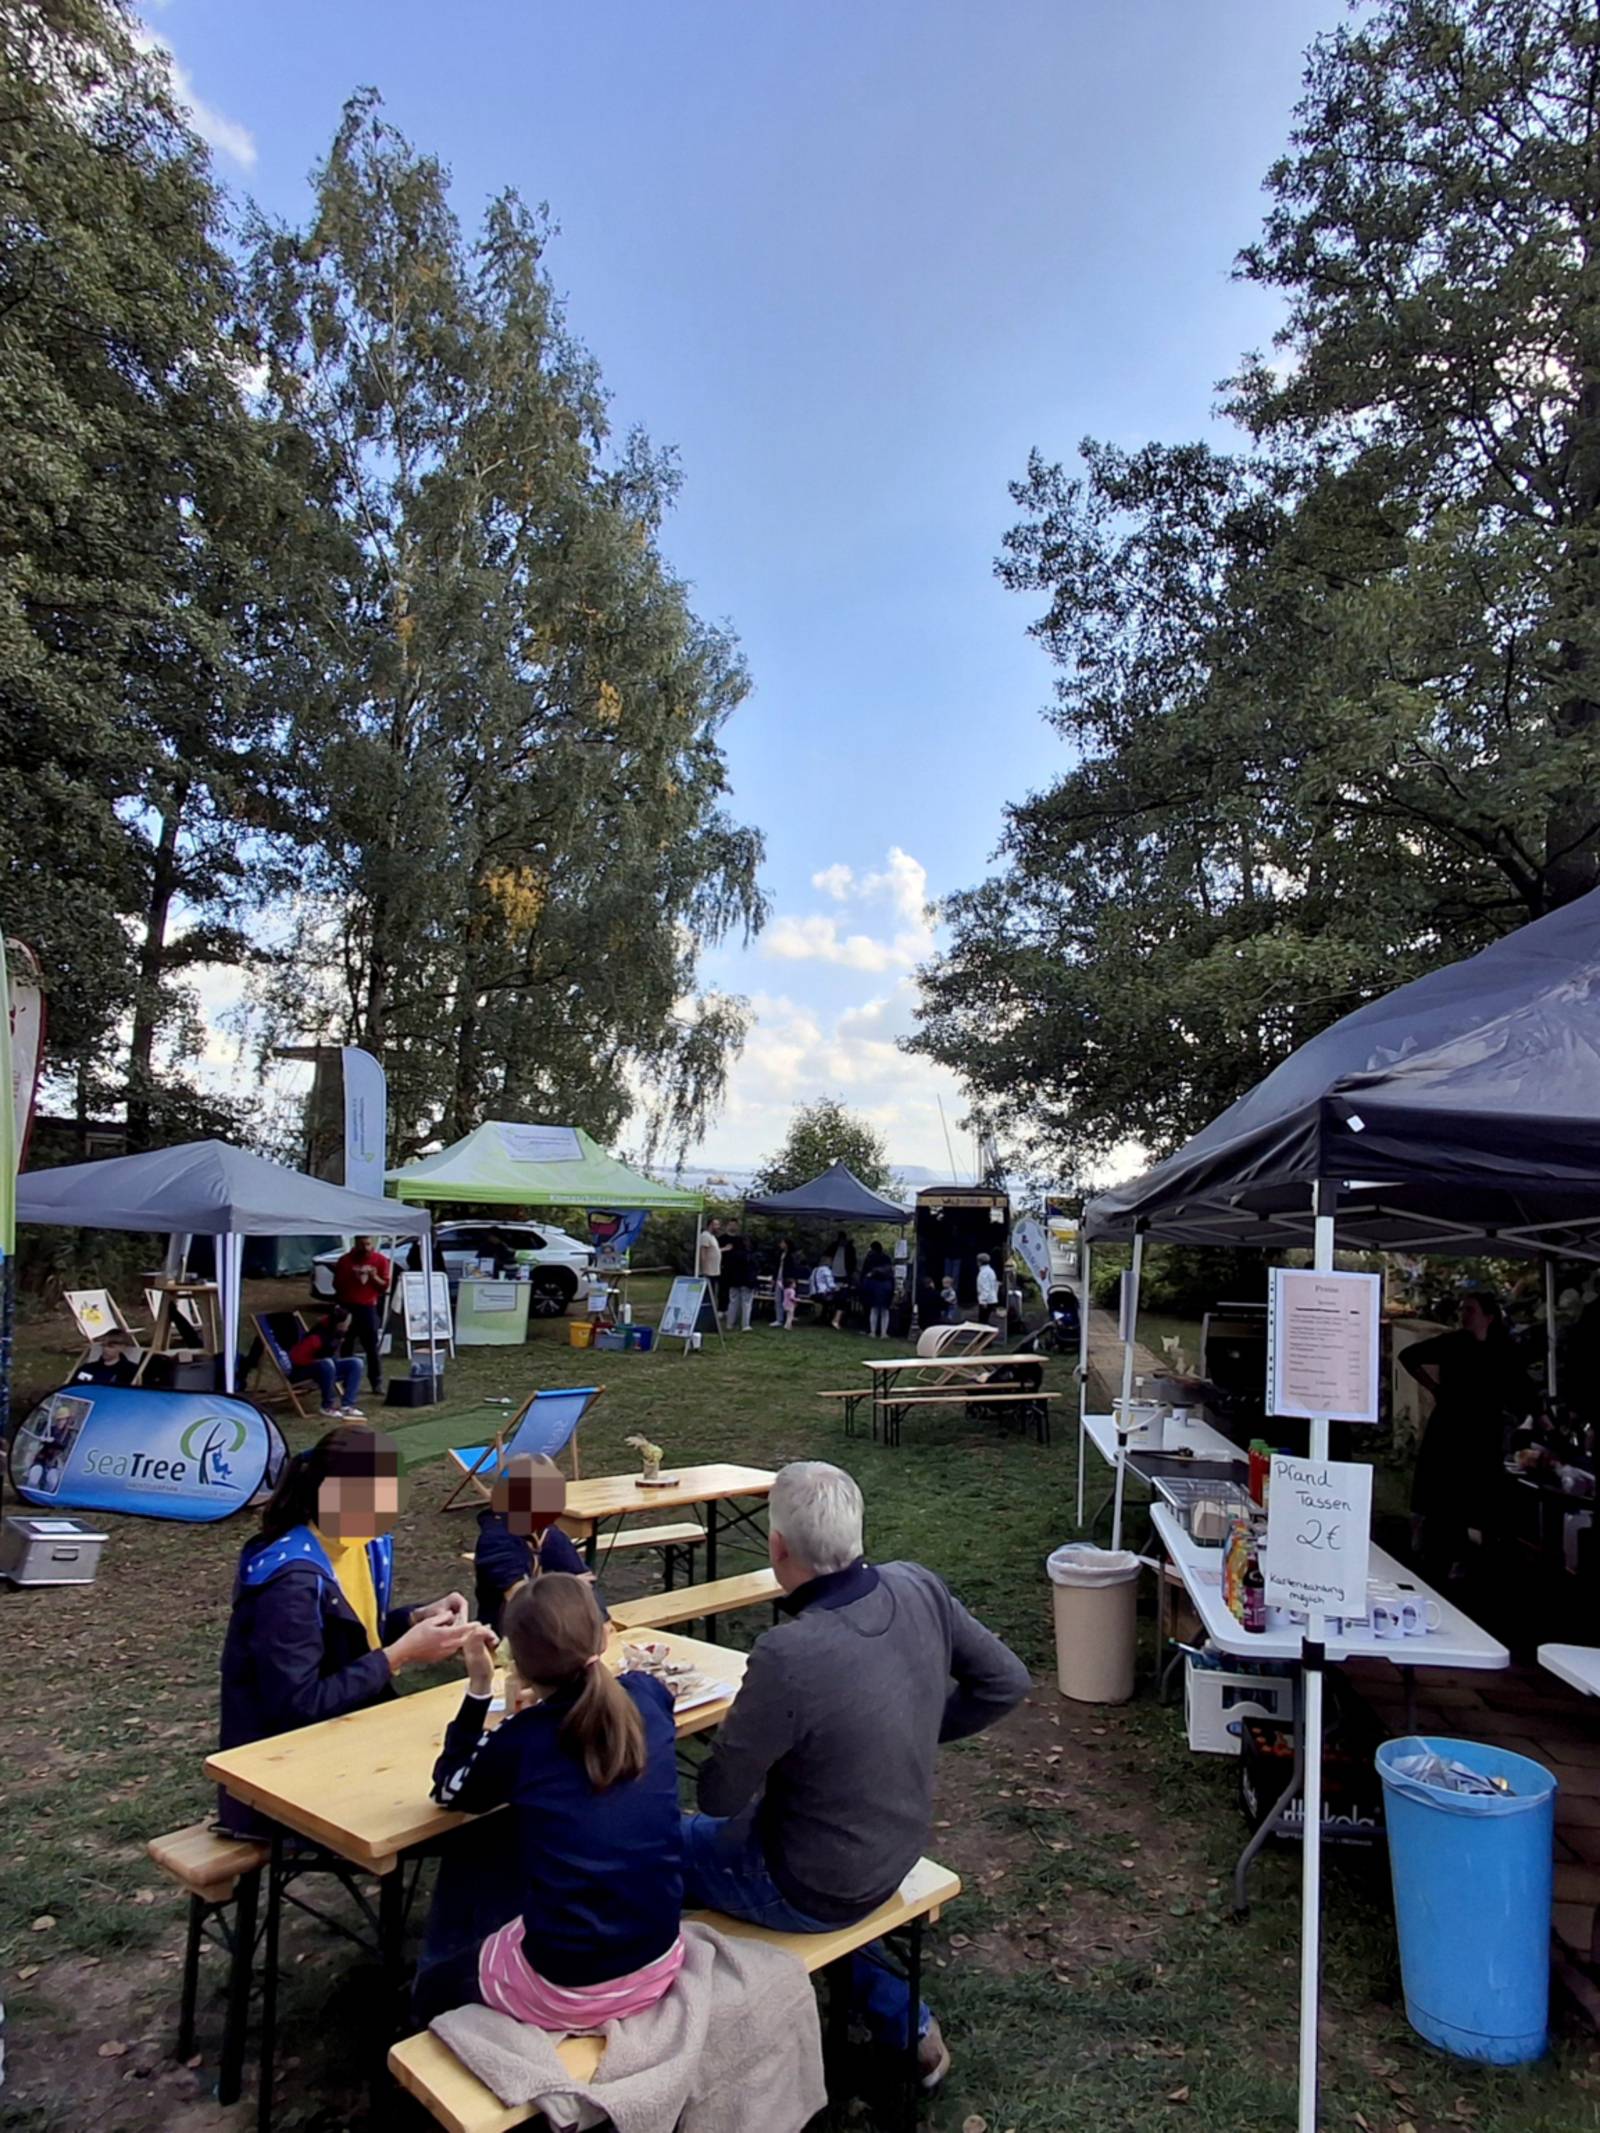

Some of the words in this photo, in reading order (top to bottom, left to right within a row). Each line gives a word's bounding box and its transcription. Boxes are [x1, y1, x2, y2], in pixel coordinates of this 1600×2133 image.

[83, 1448, 186, 1481] SeaTree
[1274, 1461, 1332, 1488] Pfand
[1296, 1491, 1352, 1511] Tassen
[1296, 1519, 1342, 1550] 2€
